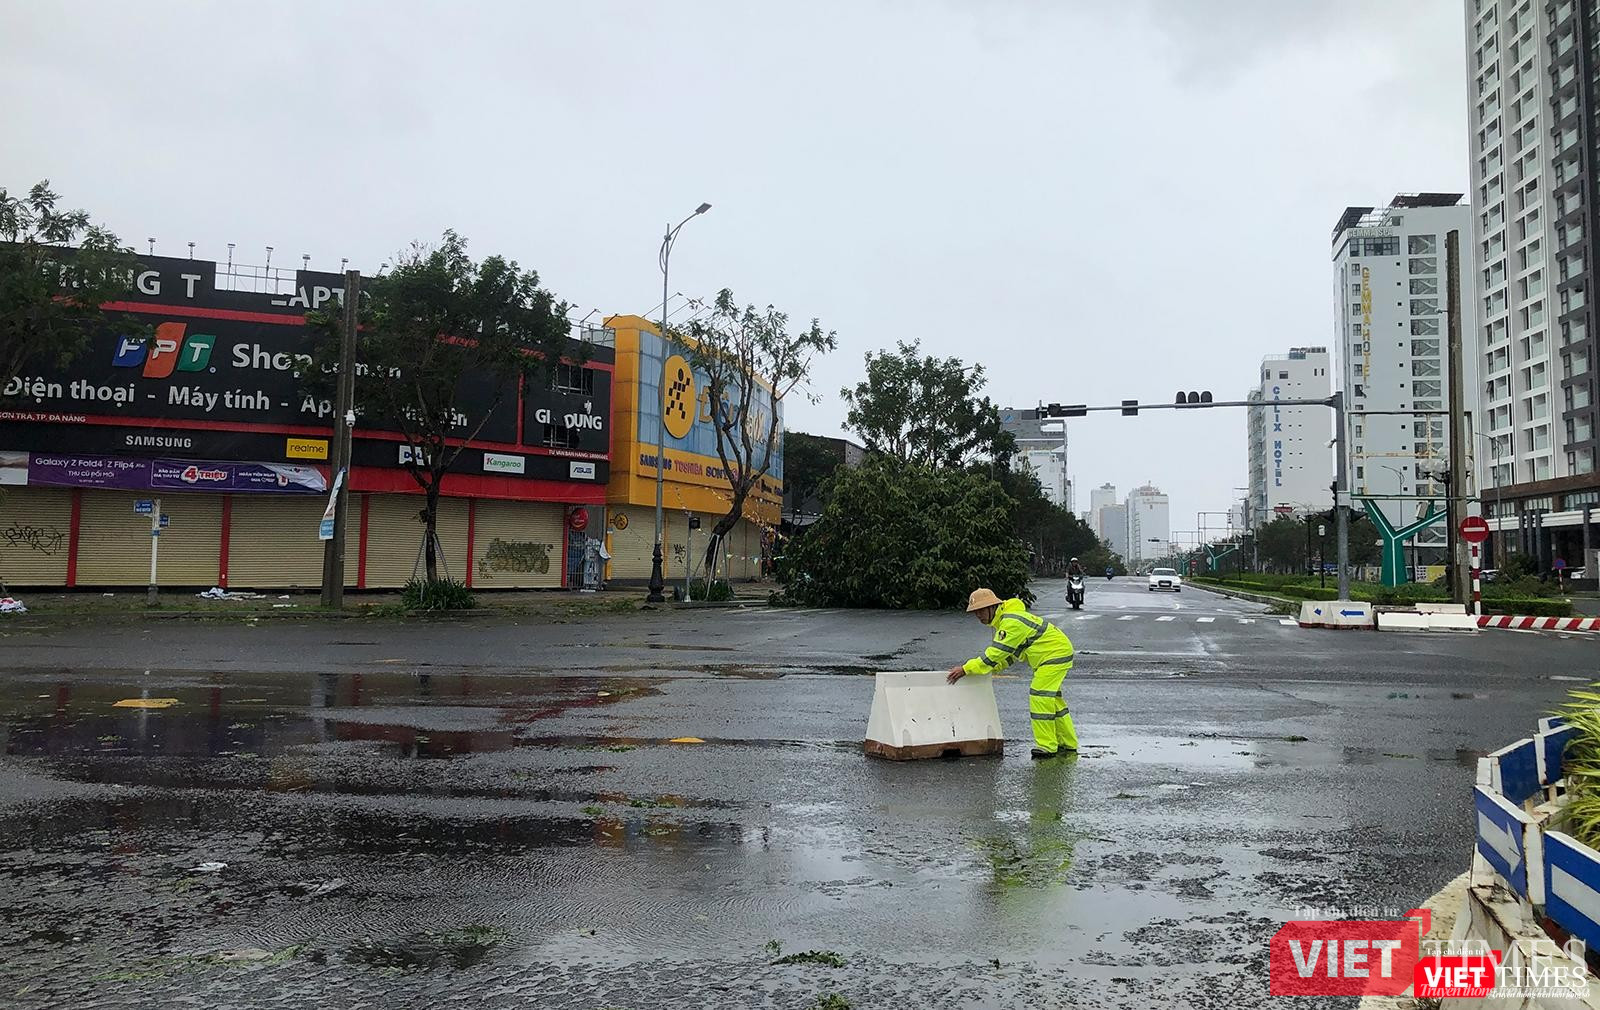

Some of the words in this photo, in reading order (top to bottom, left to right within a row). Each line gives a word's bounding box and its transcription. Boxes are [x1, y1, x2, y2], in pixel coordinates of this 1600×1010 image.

[1362, 266, 1371, 326] GEMMA
[3, 376, 63, 403] Điện
[70, 379, 135, 408] thoại
[168, 386, 219, 412] Máy
[224, 389, 270, 410] tính
[126, 435, 192, 448] SAMSUNG
[290, 443, 324, 453] realme
[36, 458, 68, 468] Galaxy
[114, 461, 134, 470] Flip4
[486, 457, 521, 468] Kangaroo
[1274, 440, 1282, 487] HOTEL
[184, 467, 197, 481] 4
[200, 470, 226, 480] TRIỆU
[574, 466, 592, 474] ASUS
